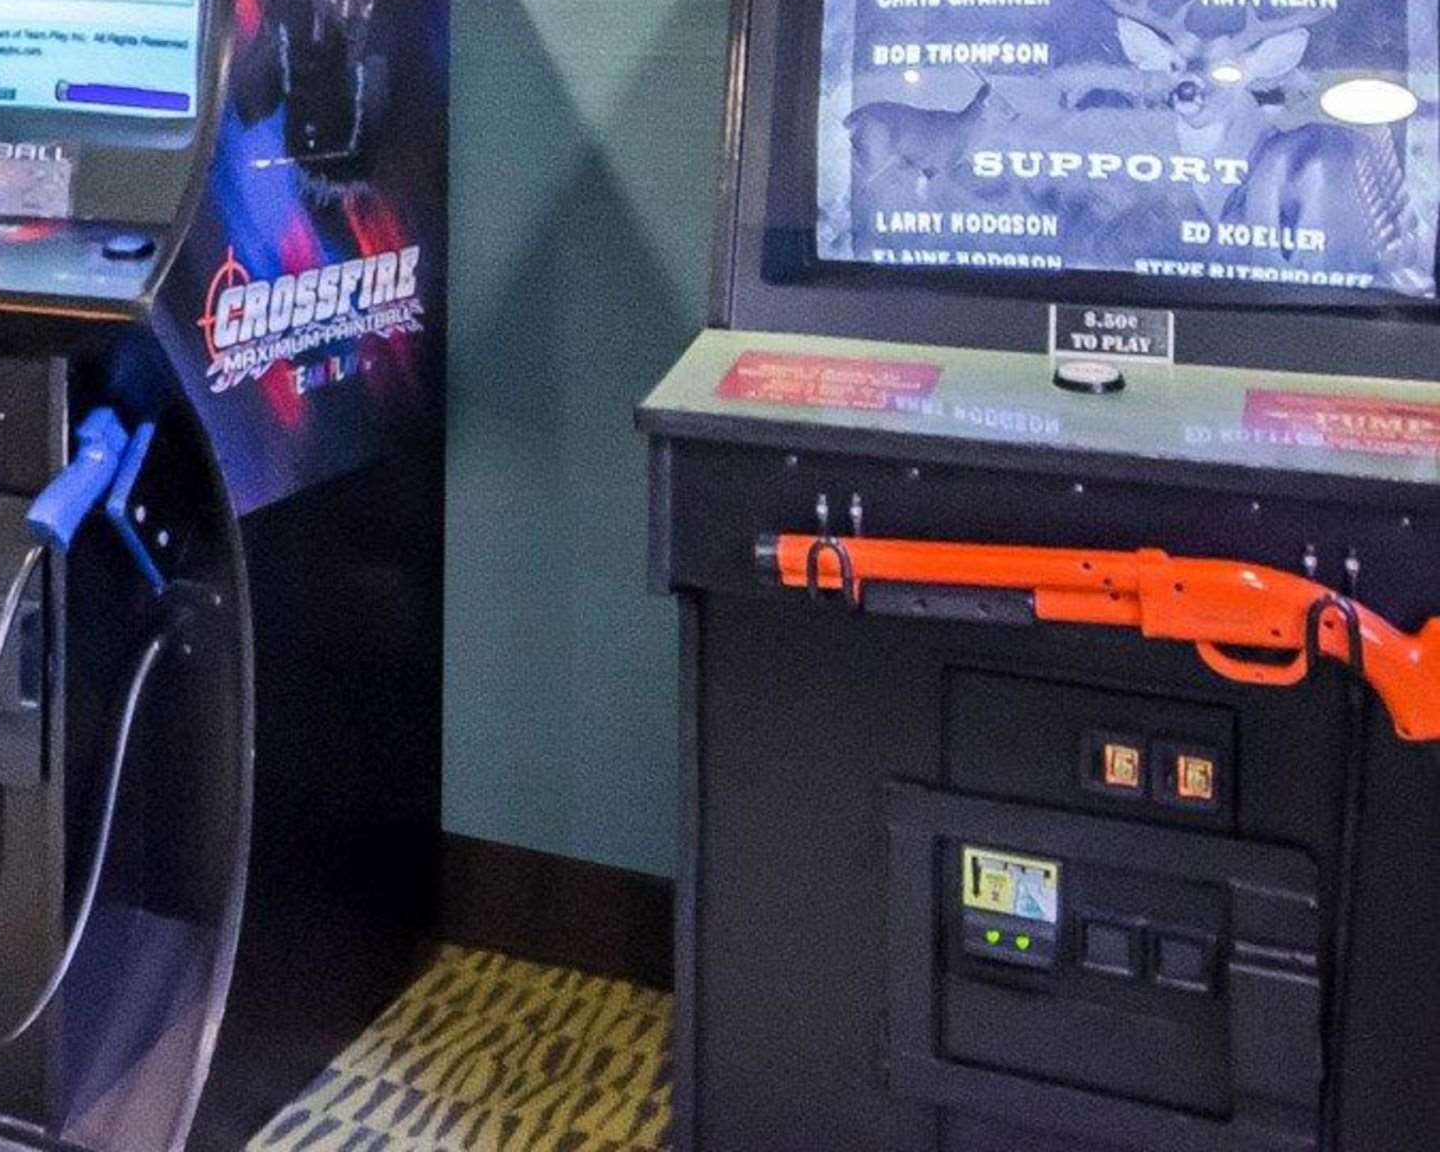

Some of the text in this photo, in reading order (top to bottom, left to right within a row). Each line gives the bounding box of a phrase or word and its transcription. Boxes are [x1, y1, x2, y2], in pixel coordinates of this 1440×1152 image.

[872, 43, 1050, 65] BOB THOMPSON
[972, 150, 1249, 185] SUPPORT
[876, 211, 1058, 237] LARRY HODGSON
[1181, 219, 1326, 252] ED KOELLER
[214, 244, 421, 350] CROSSFIRE
[222, 305, 410, 375] MAXIMUM PAINTBALL
[1070, 332, 1152, 353] TO PLAY
